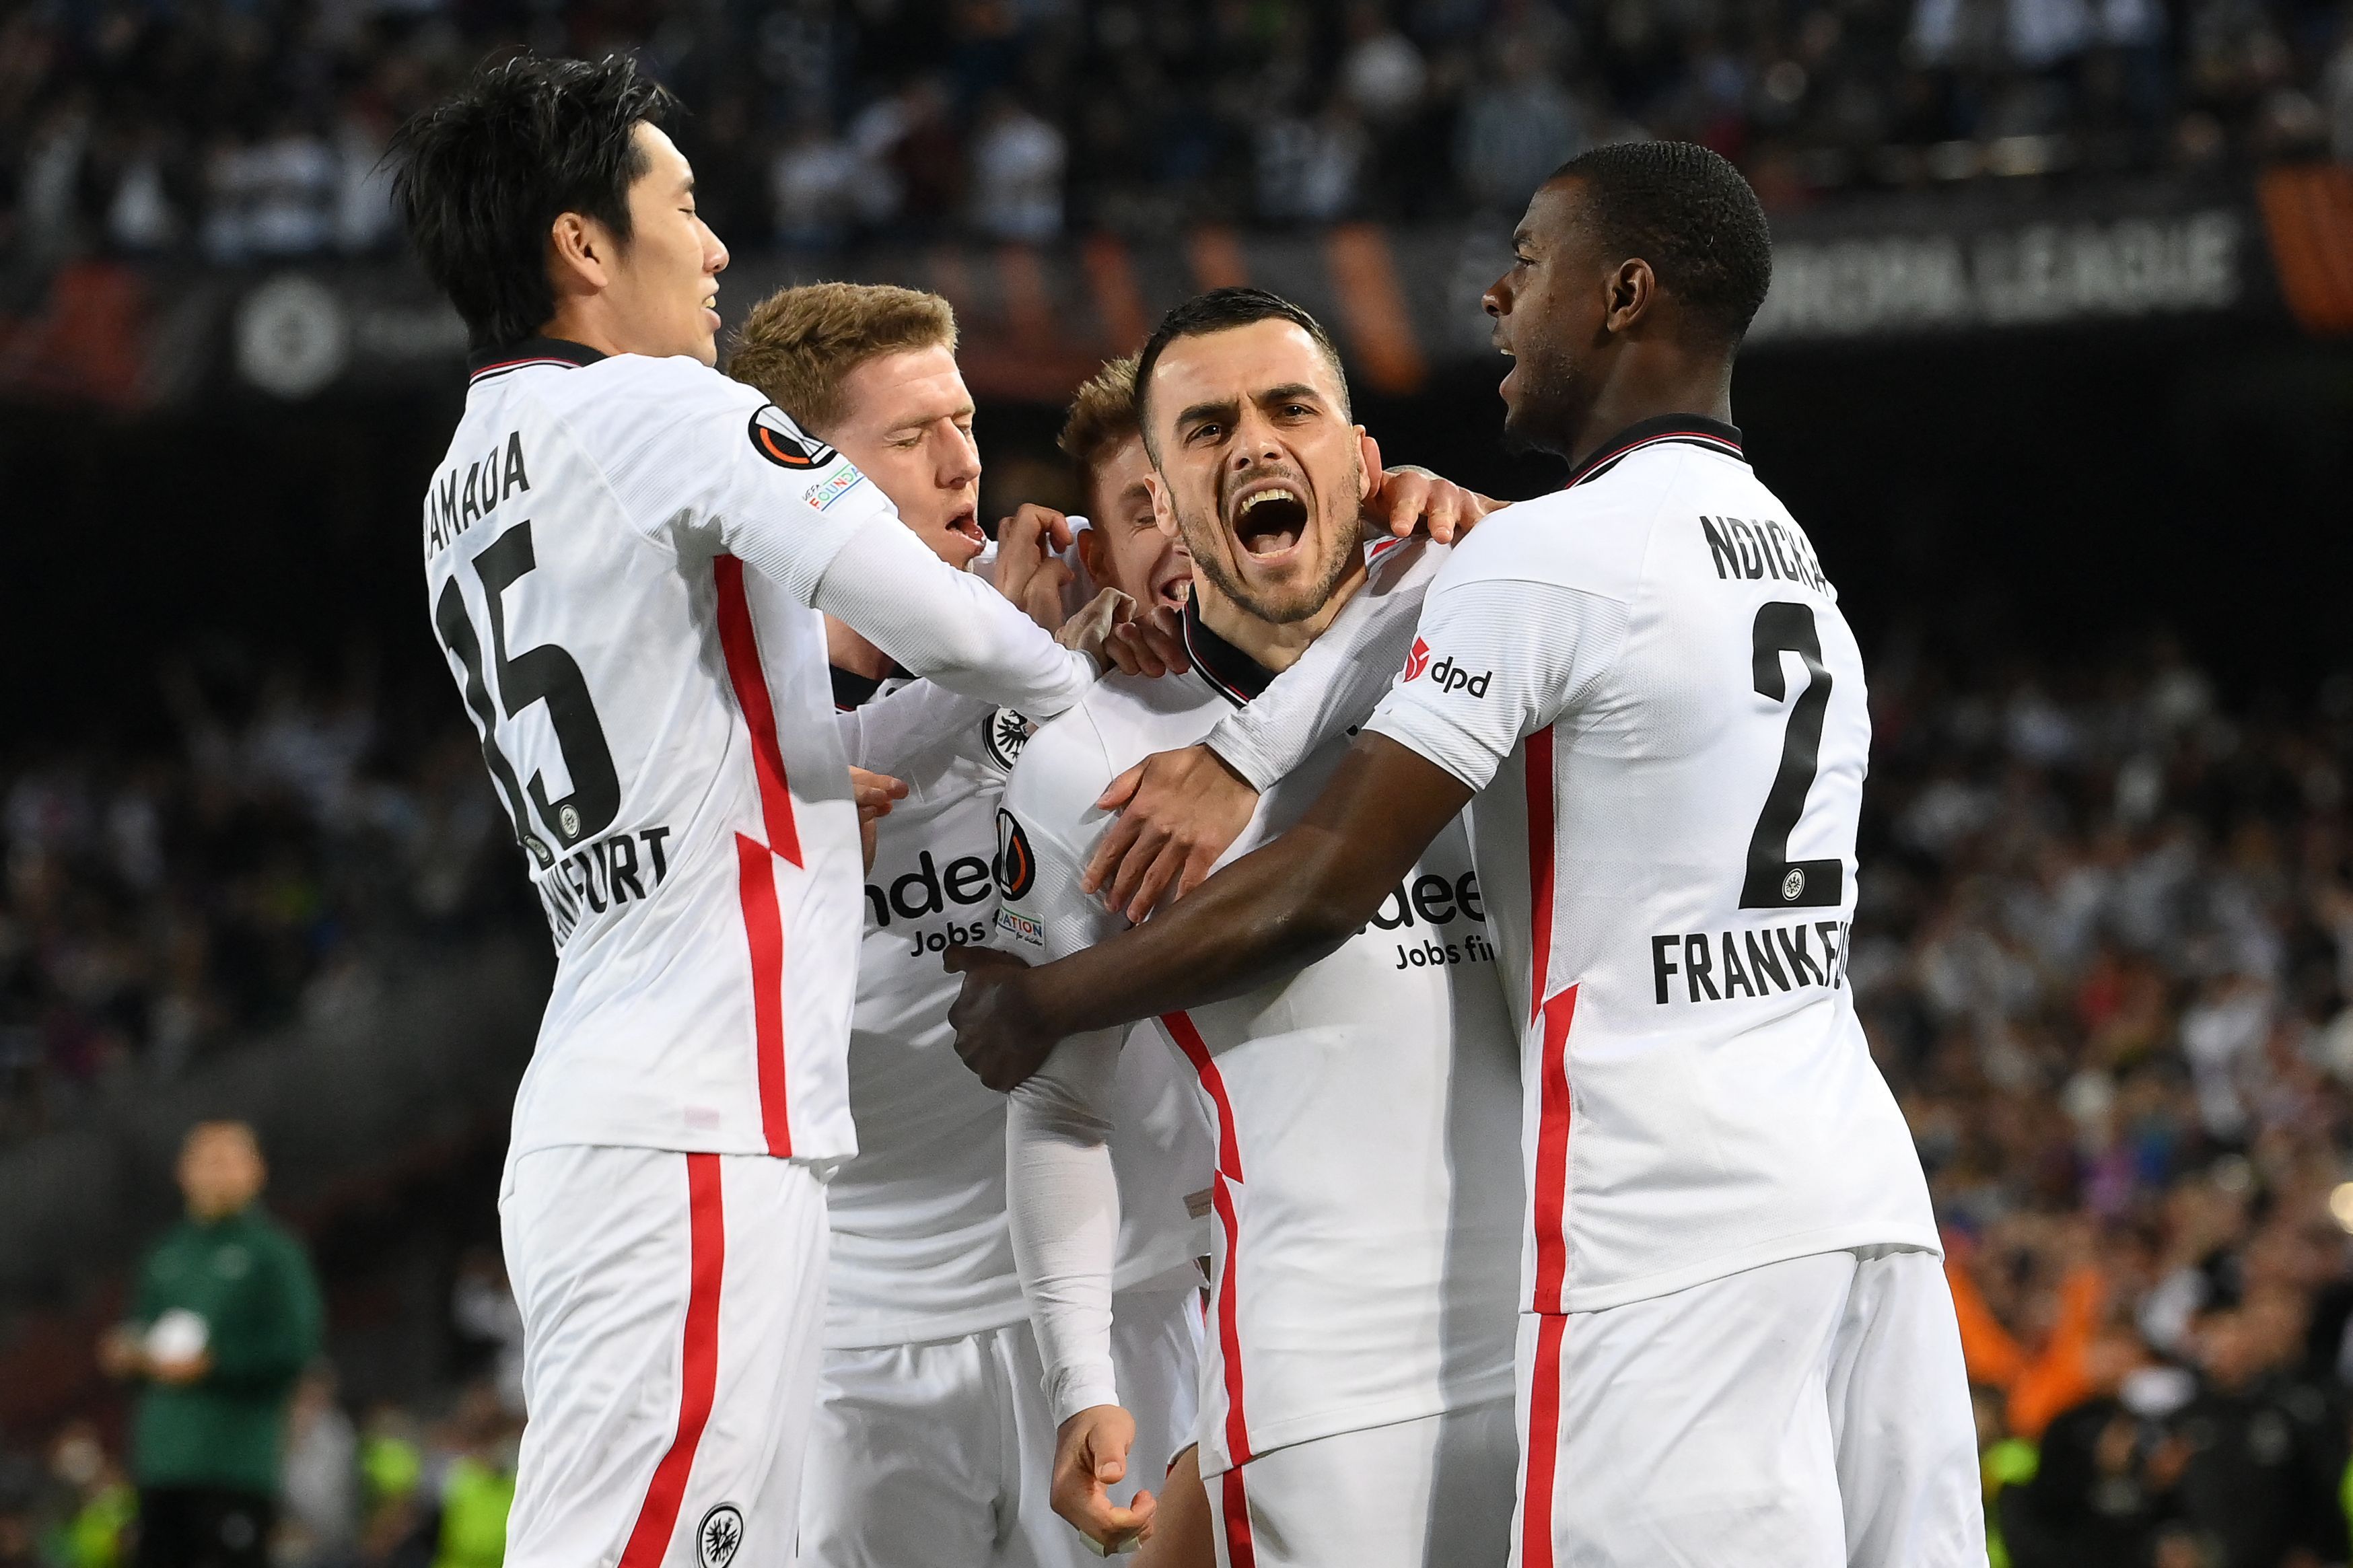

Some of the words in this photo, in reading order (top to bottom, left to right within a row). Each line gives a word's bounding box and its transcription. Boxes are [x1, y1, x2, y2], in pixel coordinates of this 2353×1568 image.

[426, 431, 530, 560] AMADA
[1699, 515, 1829, 598] NDICKA
[435, 519, 620, 870] 15
[1431, 656, 1493, 699] dpd
[1738, 601, 1843, 909] 2
[911, 922, 986, 957] Jobs
[1397, 939, 1461, 970] Jobs
[1652, 921, 1850, 1005] FRANKFU
